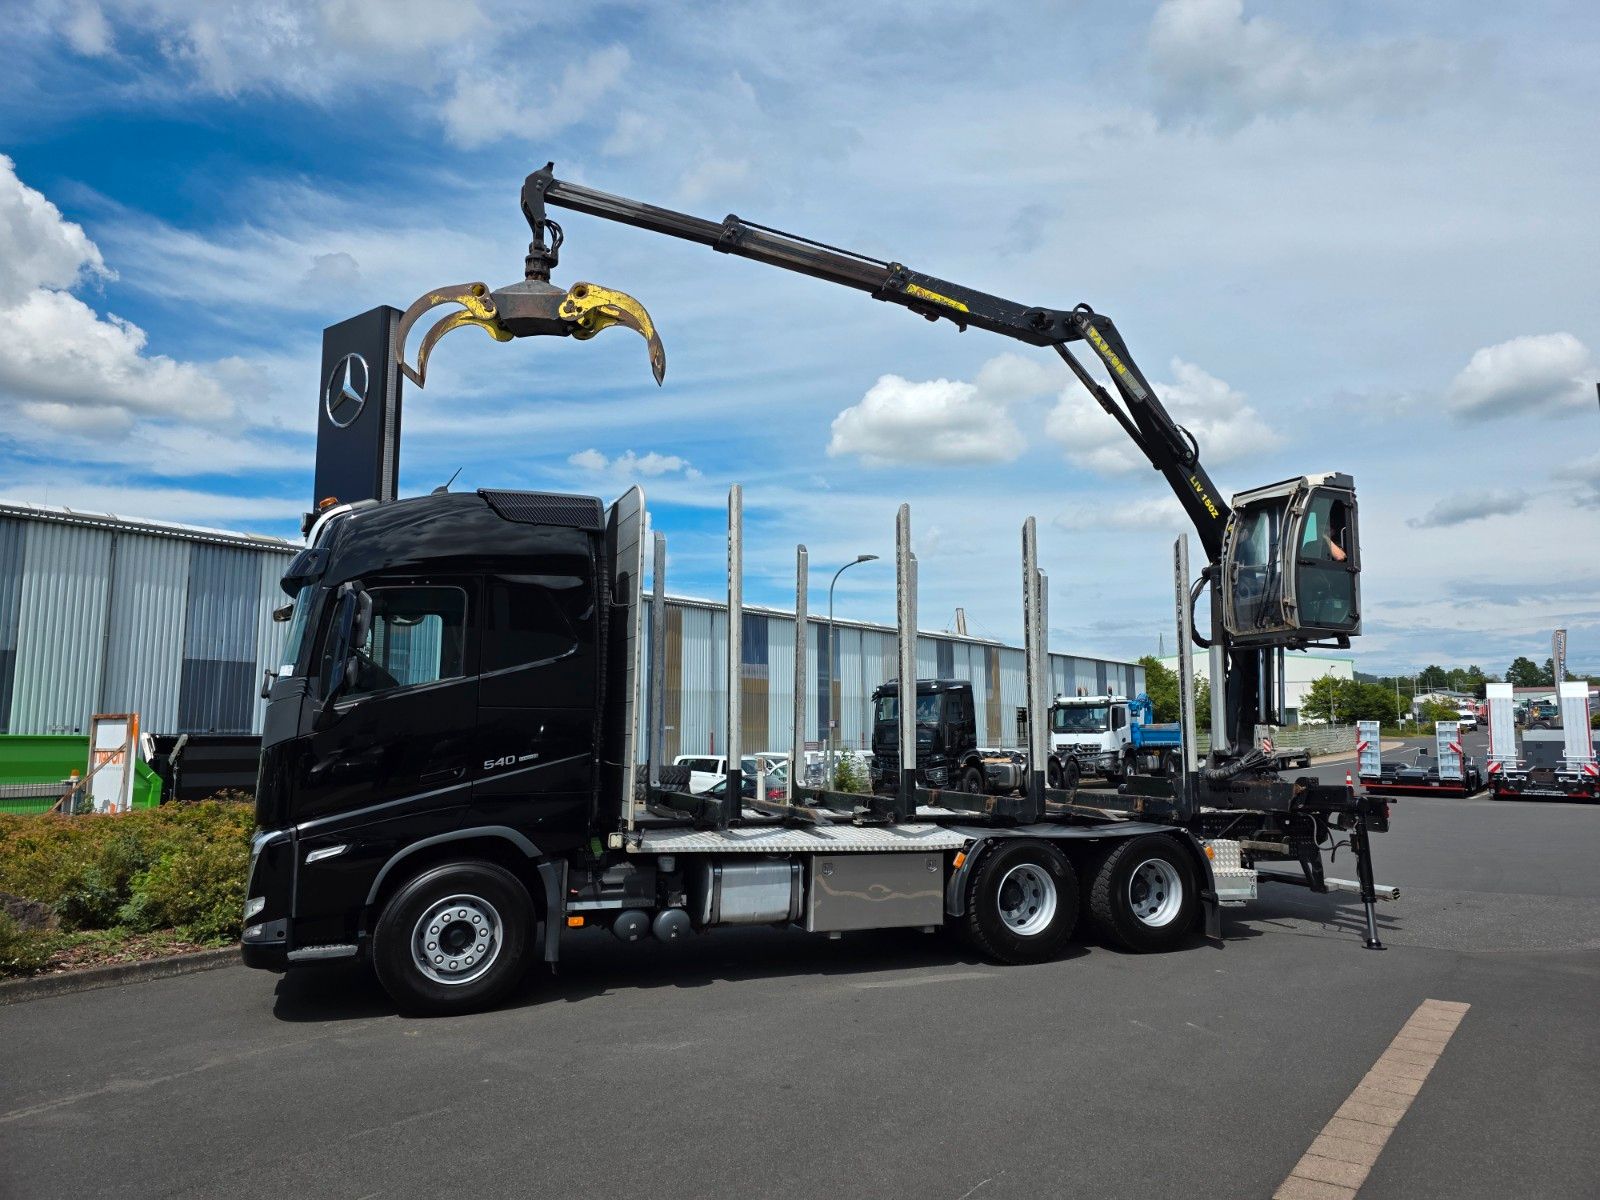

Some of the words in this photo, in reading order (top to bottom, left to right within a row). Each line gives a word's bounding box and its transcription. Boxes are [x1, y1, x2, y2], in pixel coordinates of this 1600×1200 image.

[1190, 476, 1203, 492] LIV
[1202, 494, 1219, 519] 150Z
[483, 755, 516, 770] 540
